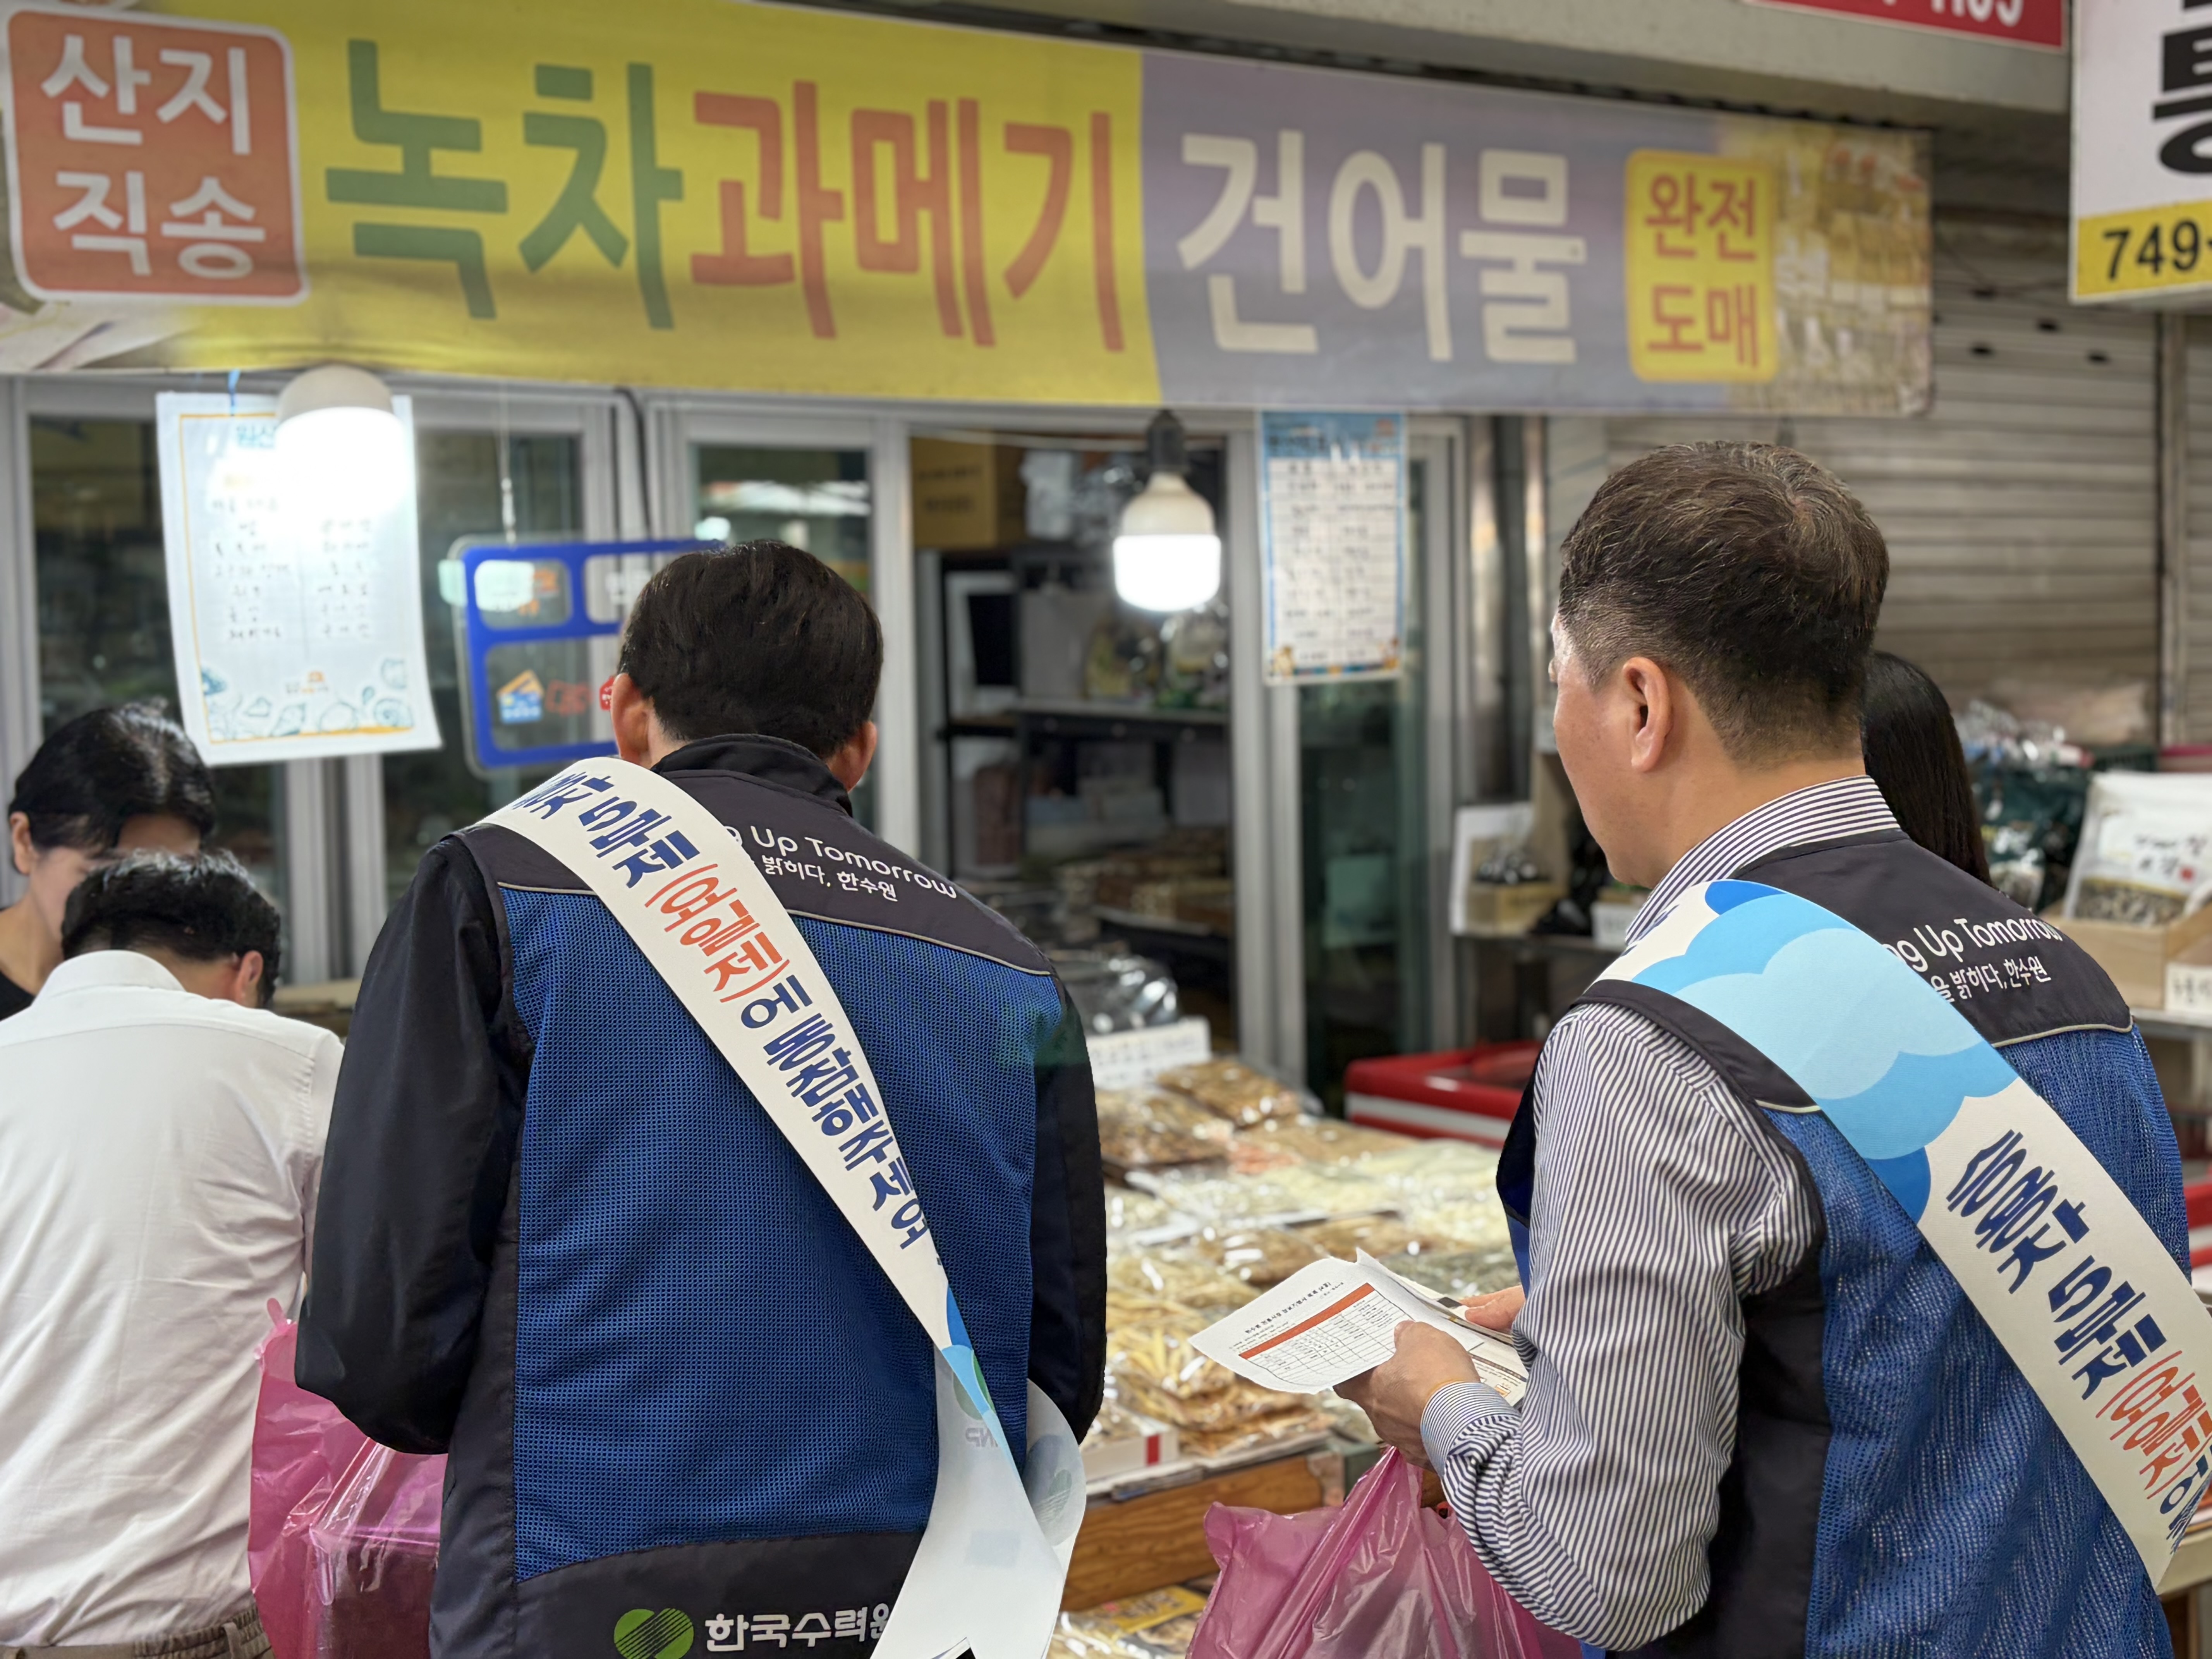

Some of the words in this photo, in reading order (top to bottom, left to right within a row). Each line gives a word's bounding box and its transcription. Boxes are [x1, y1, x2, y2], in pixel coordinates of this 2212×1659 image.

[41, 34, 251, 155] 산지
[53, 170, 266, 279] 직송
[1176, 129, 1587, 363] 건어물
[1644, 172, 1759, 262] 완전
[1646, 285, 1760, 368] 도매
[750, 826, 798, 856] Up
[804, 836, 957, 899] Tomorrow
[837, 870, 898, 902] 한수원
[1913, 924, 1964, 963] Up
[1954, 918, 2063, 948] Tomorrow
[2003, 956, 2052, 988] 한수원
[1946, 1129, 2090, 1295] 승용차
